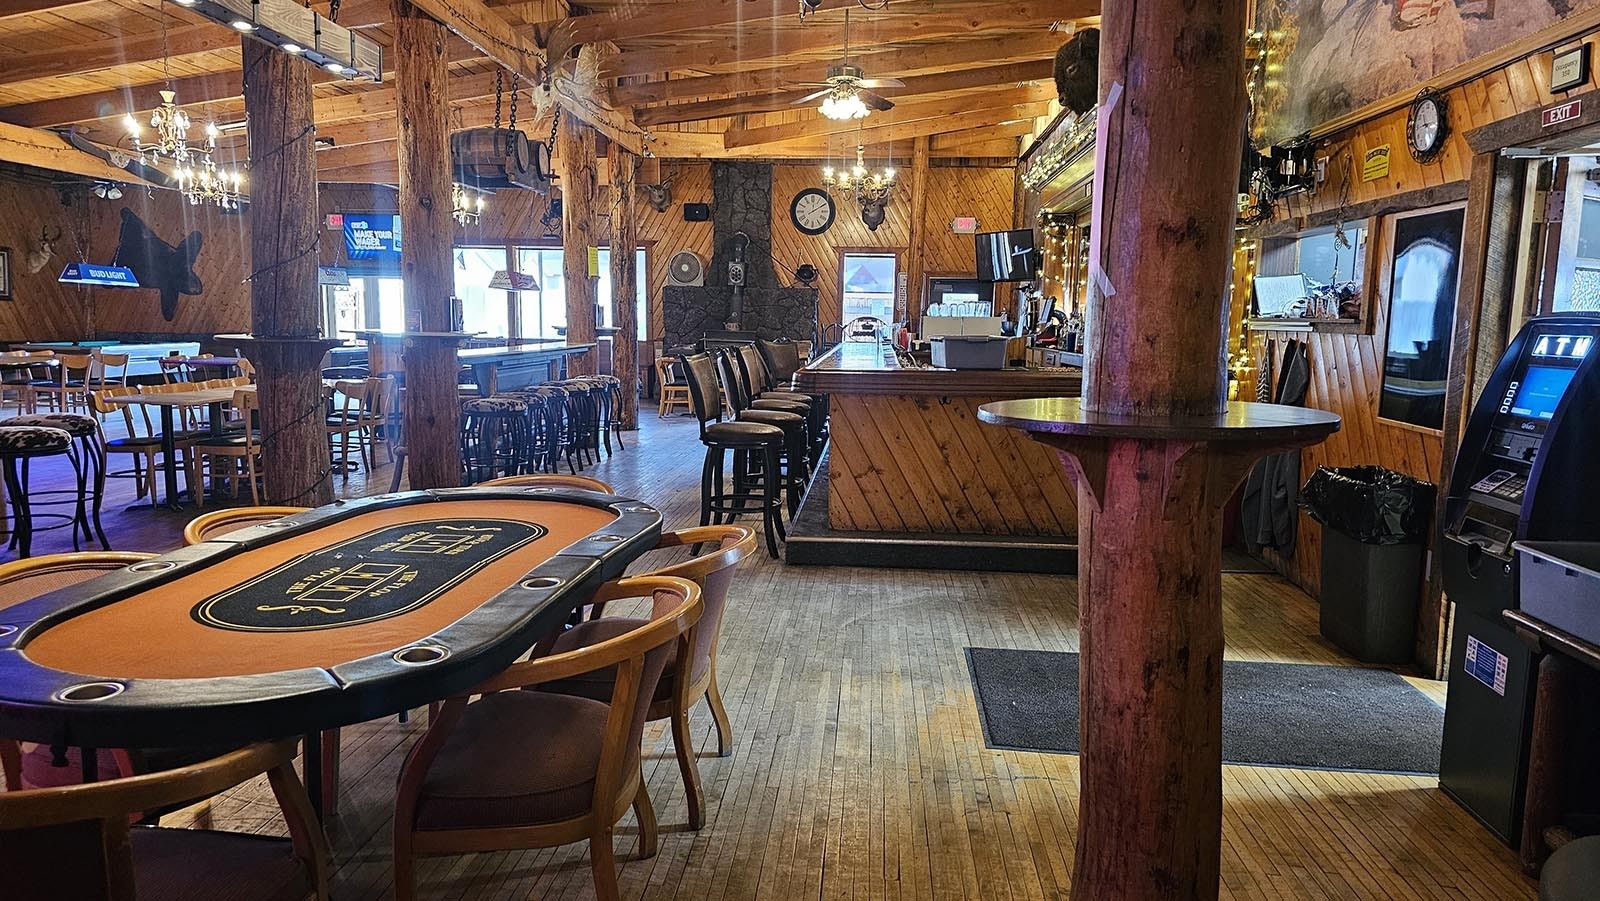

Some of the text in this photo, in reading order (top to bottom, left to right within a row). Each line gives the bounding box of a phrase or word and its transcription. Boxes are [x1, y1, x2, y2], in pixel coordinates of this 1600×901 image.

[1550, 105, 1572, 123] EXIT
[354, 230, 392, 239] MAKE YOUR
[355, 237, 380, 246] WAGER
[89, 270, 127, 280] BUD LIGHT
[1534, 337, 1590, 356] ATM
[286, 566, 341, 594] THE FLOP
